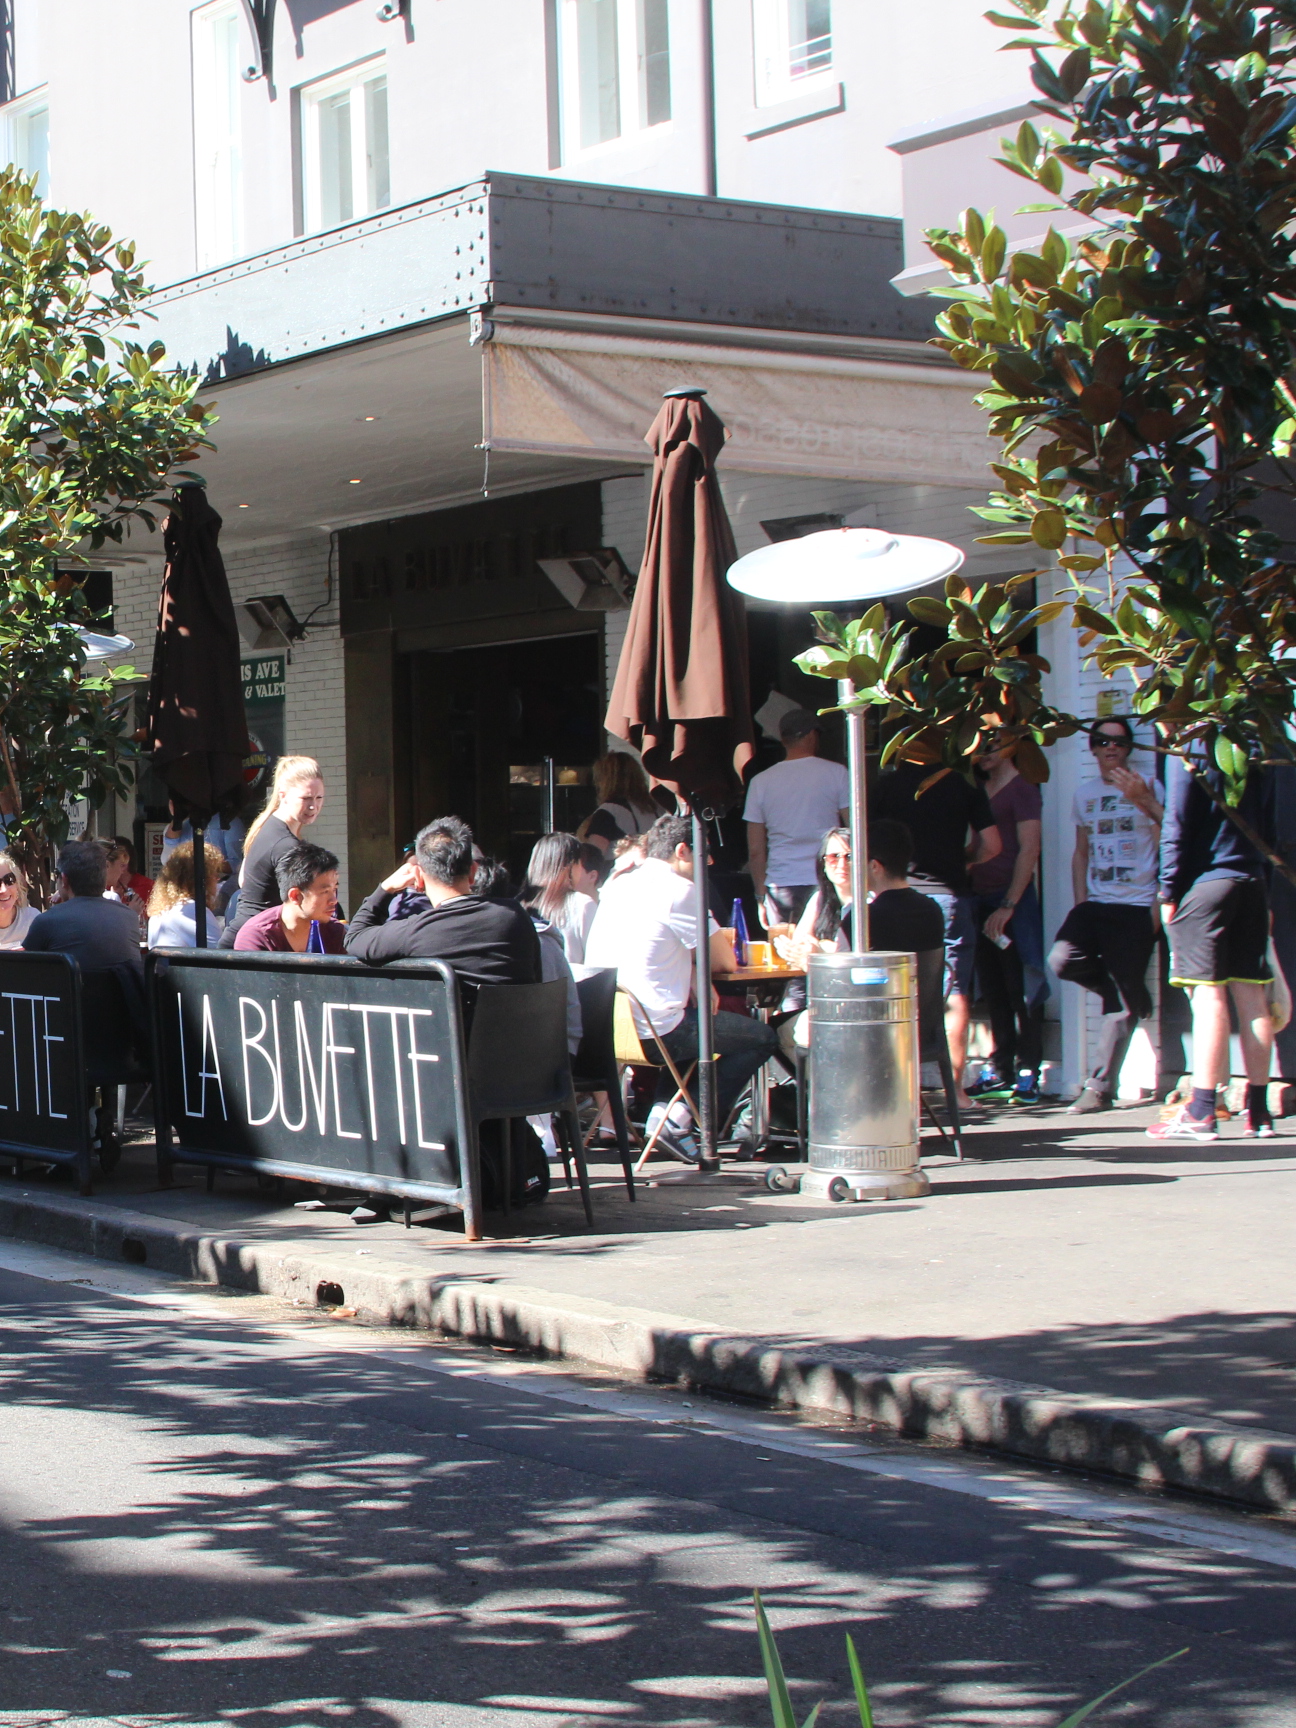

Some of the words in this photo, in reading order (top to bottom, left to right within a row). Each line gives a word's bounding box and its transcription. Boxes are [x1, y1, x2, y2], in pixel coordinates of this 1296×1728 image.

[240, 664, 252, 682] IS
[255, 660, 280, 680] AVE
[255, 682, 285, 698] VALET
[177, 992, 227, 1121] LA
[239, 996, 446, 1151] BUVETTE
